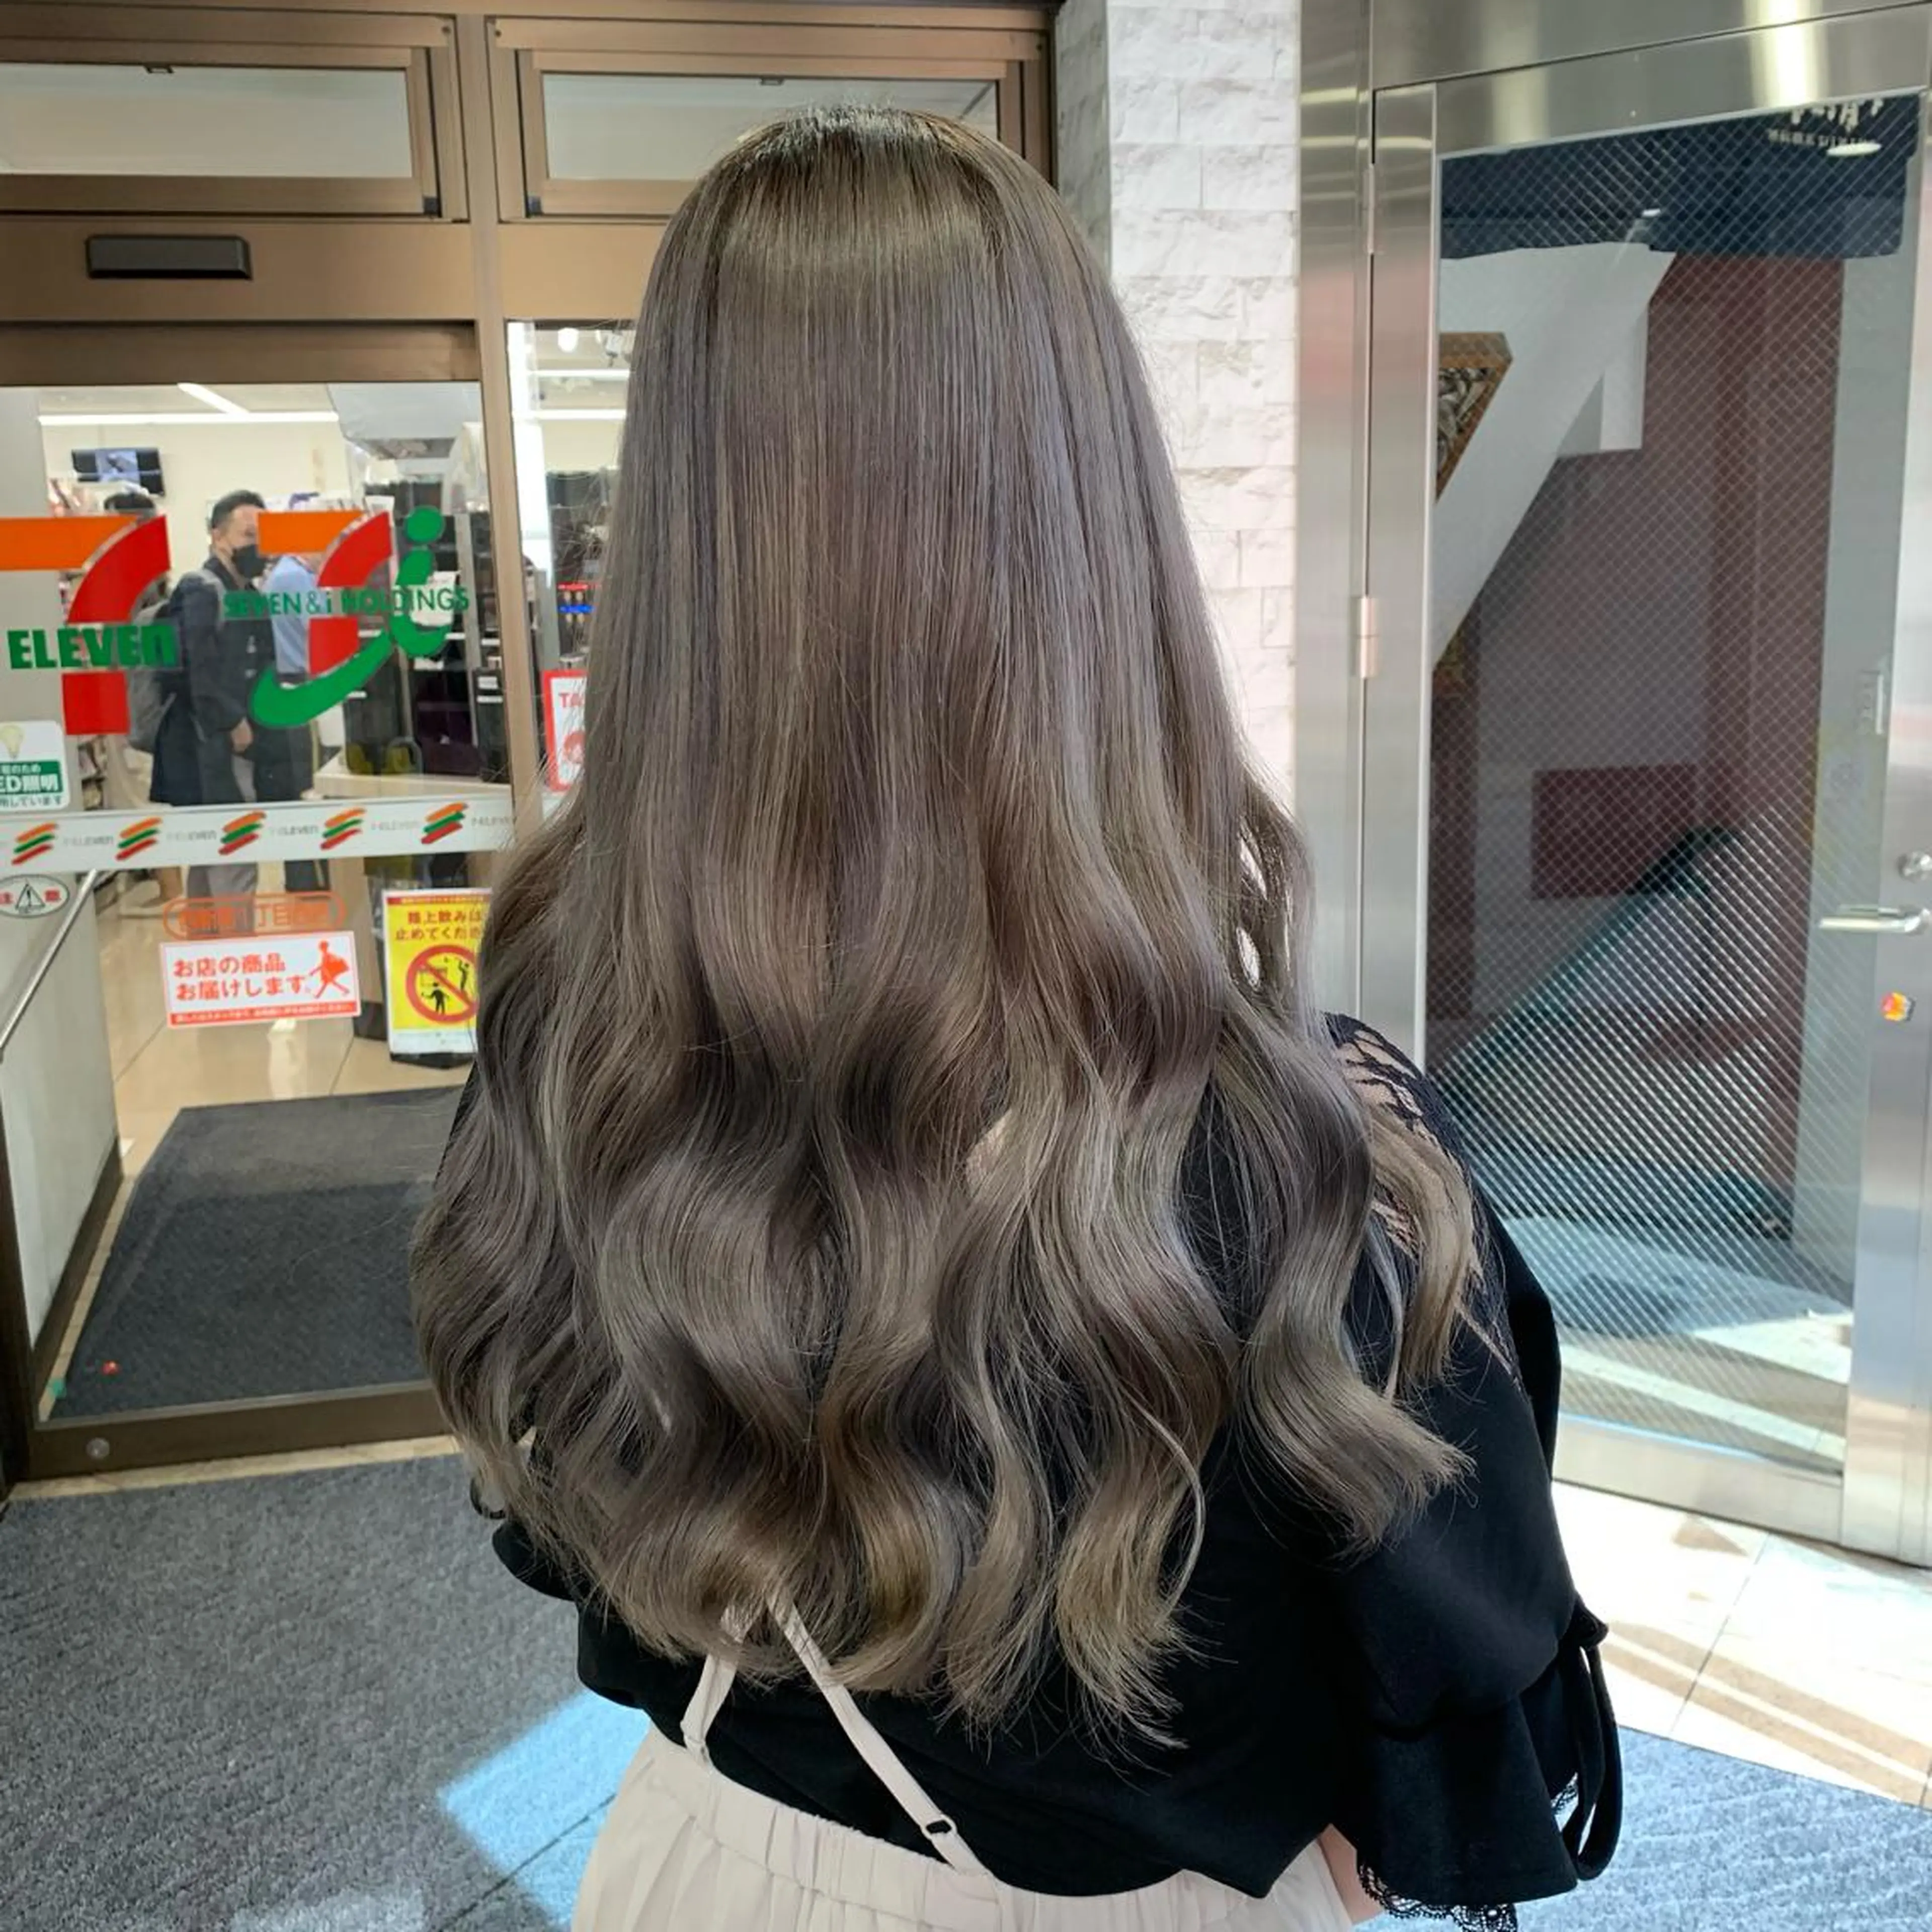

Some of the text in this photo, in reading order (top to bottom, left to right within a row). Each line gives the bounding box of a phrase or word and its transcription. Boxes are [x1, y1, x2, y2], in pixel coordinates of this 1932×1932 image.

[174, 952, 286, 978] お店の商品
